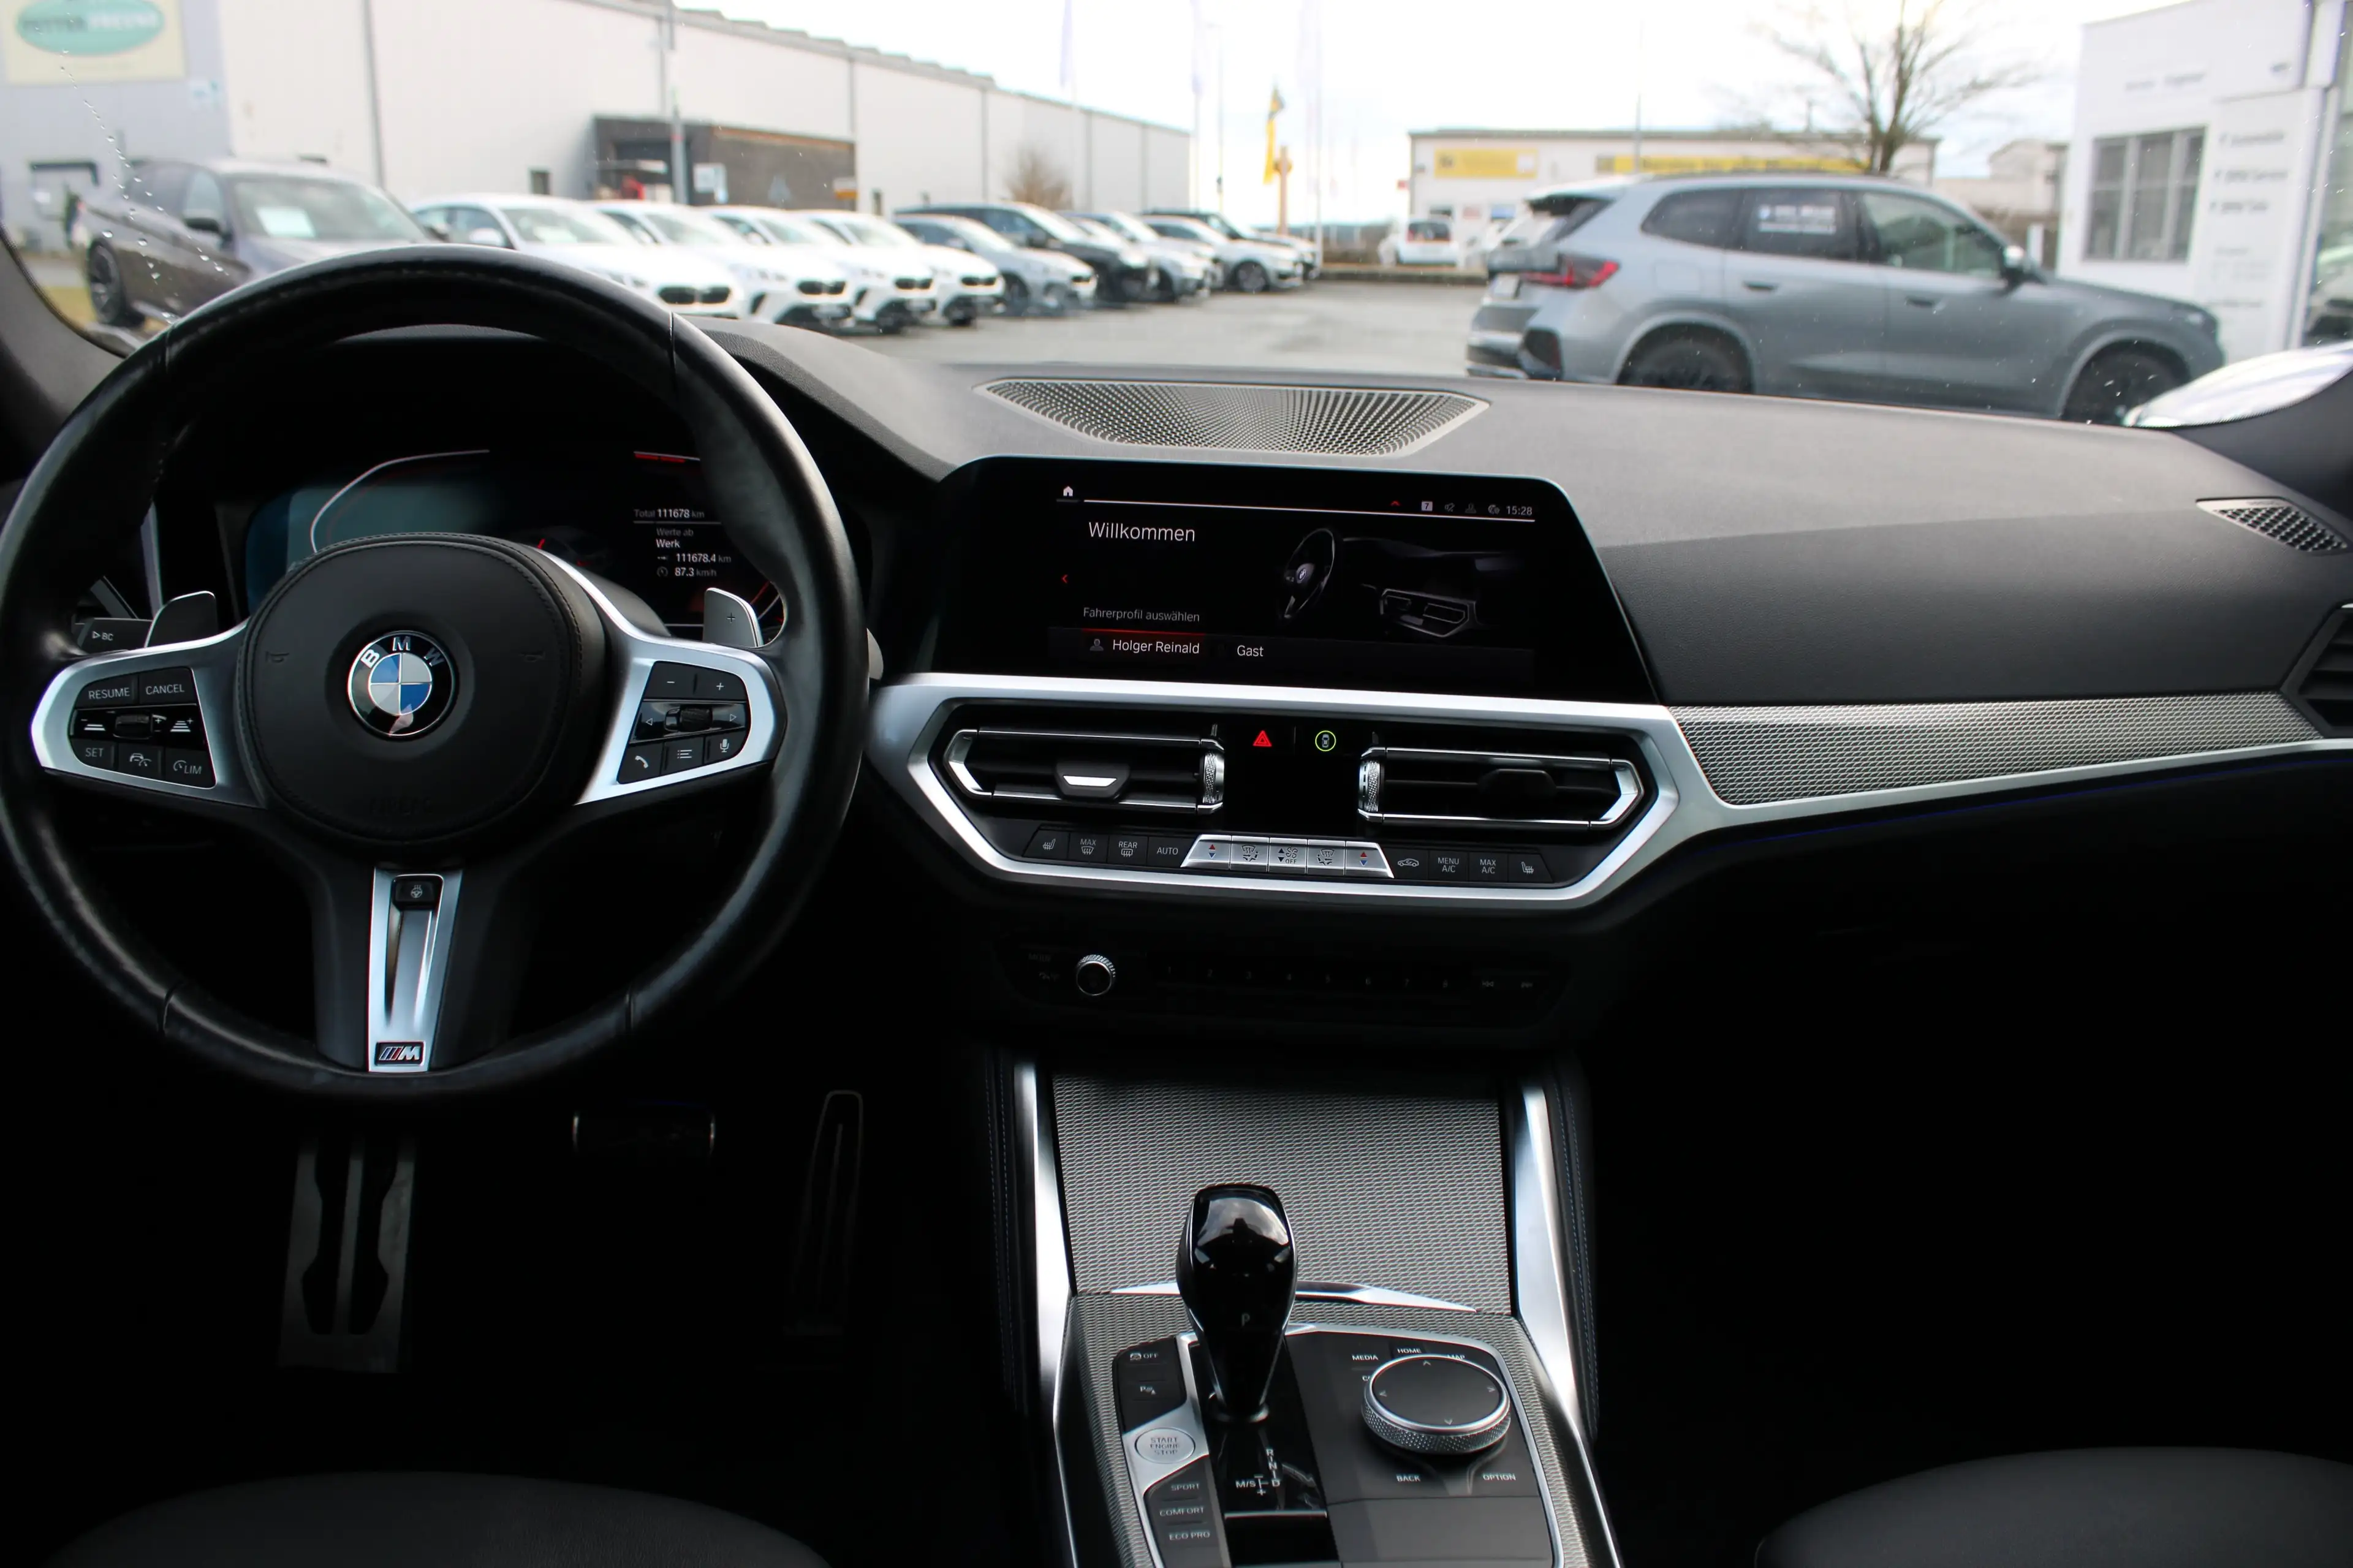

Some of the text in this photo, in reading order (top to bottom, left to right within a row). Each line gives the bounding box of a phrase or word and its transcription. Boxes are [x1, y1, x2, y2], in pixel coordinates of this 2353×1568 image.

[634, 508, 705, 518] Total 111678 km
[1506, 506, 1533, 516] 15:28
[656, 528, 694, 537] Werte ab
[1088, 521, 1195, 542] Willkommen
[656, 539, 680, 548] Werk
[675, 553, 732, 563] 111678.4 km
[675, 567, 717, 577] 87.3 km/h
[1083, 607, 1200, 623] Fahrerprofil auswählen
[102, 632, 113, 641] BC
[1112, 639, 1200, 654] Holger Reinald
[1237, 644, 1264, 657] Gast
[360, 635, 445, 669] BMW
[88, 687, 131, 699] RESUME
[145, 684, 185, 695] CANCEL
[85, 748, 104, 757] SET
[183, 763, 202, 775] LIM
[1118, 841, 1138, 849] REAR
[1156, 847, 1178, 855] AUTO
[1441, 865, 1457, 873] A/C
[1481, 865, 1496, 874] A/C
[1241, 1313, 1251, 1327] P
[1268, 1461, 1277, 1470] N
[1170, 1483, 1200, 1491] SPORT
[1235, 1480, 1256, 1489] M/S
[1271, 1479, 1281, 1487] D
[1159, 1506, 1205, 1517] COMFORT
[1191, 1531, 1211, 1539] PRO
